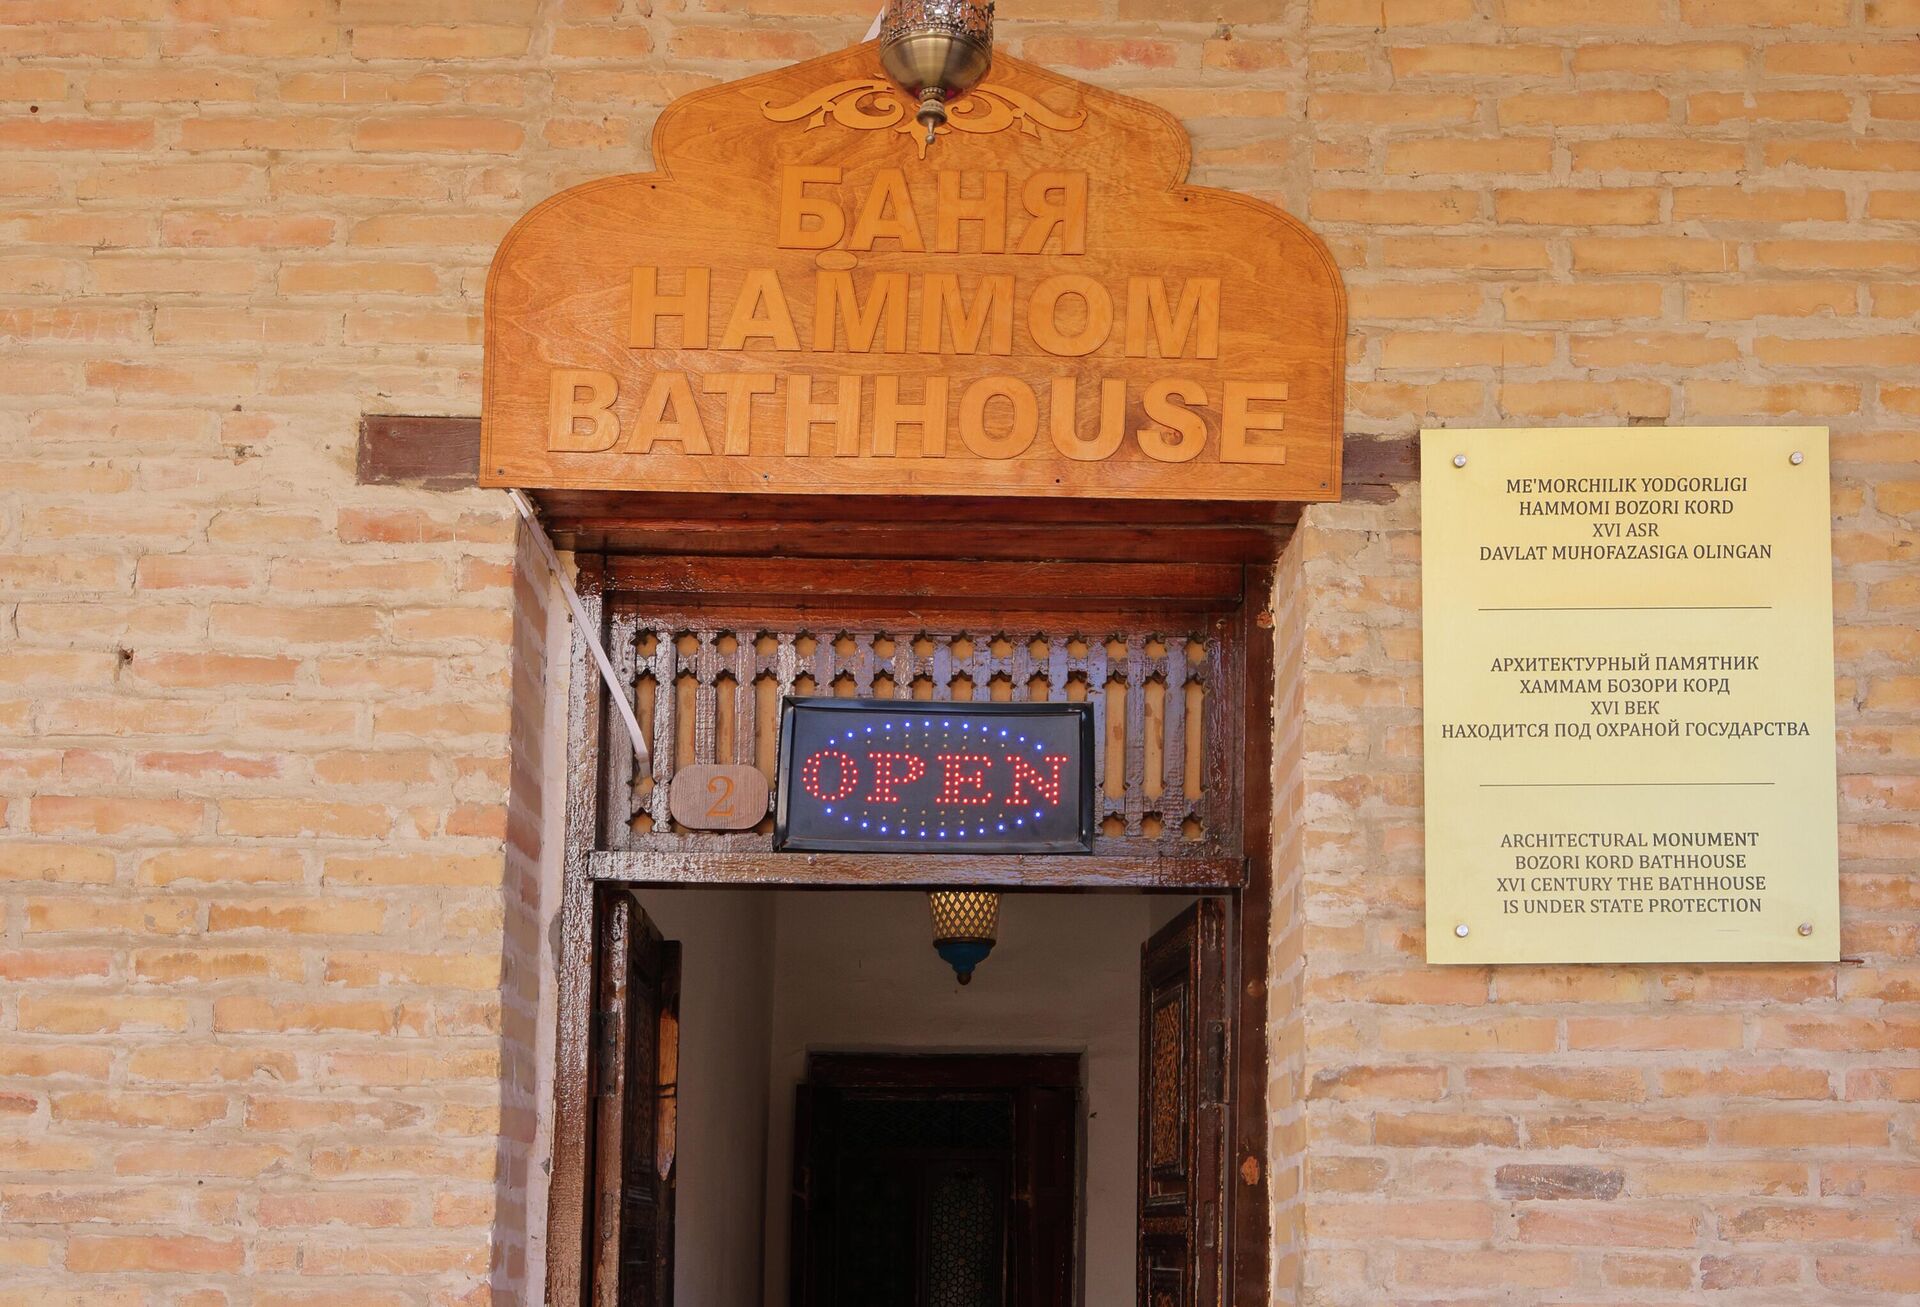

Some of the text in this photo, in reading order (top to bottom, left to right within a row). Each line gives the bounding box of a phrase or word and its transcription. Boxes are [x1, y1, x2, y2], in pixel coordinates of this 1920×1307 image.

[776, 164, 1088, 256] БАНЯ
[628, 265, 1222, 360] HAMMOM
[546, 367, 1288, 465] BATHHOUSE
[1506, 477, 1748, 494] ME'MORCHILIK YODGORLIGI
[1519, 500, 1734, 516] HAMMOMI BOZORI KORD
[1592, 523, 1659, 538] XVI ASR
[1479, 544, 1772, 561] DAVLAT MUHOFAZASIGA OLINGAN
[1490, 653, 1759, 672] АРХИТЕКТУРНЫЙ ПАМЯТНИК
[1519, 678, 1730, 696] ХАММАМ БОЗОРИ КОРД
[1590, 700, 1659, 716] XVI ВЕК
[1441, 720, 1810, 741] НАХОДИТСЯ ПОД ОХРАНОЙ ГОСУДАРСТВА
[802, 750, 1069, 806] OPEN
[705, 774, 736, 818] 2
[1500, 832, 1759, 849] ARCHITECTURAL MONUMENT
[1515, 854, 1746, 870] BOZORI KORD BATHHOUSE
[1496, 876, 1766, 892] XVI CENTURY THE BATHHOUSE
[1503, 898, 1761, 915] IS UNDER STATE PROTECTION
